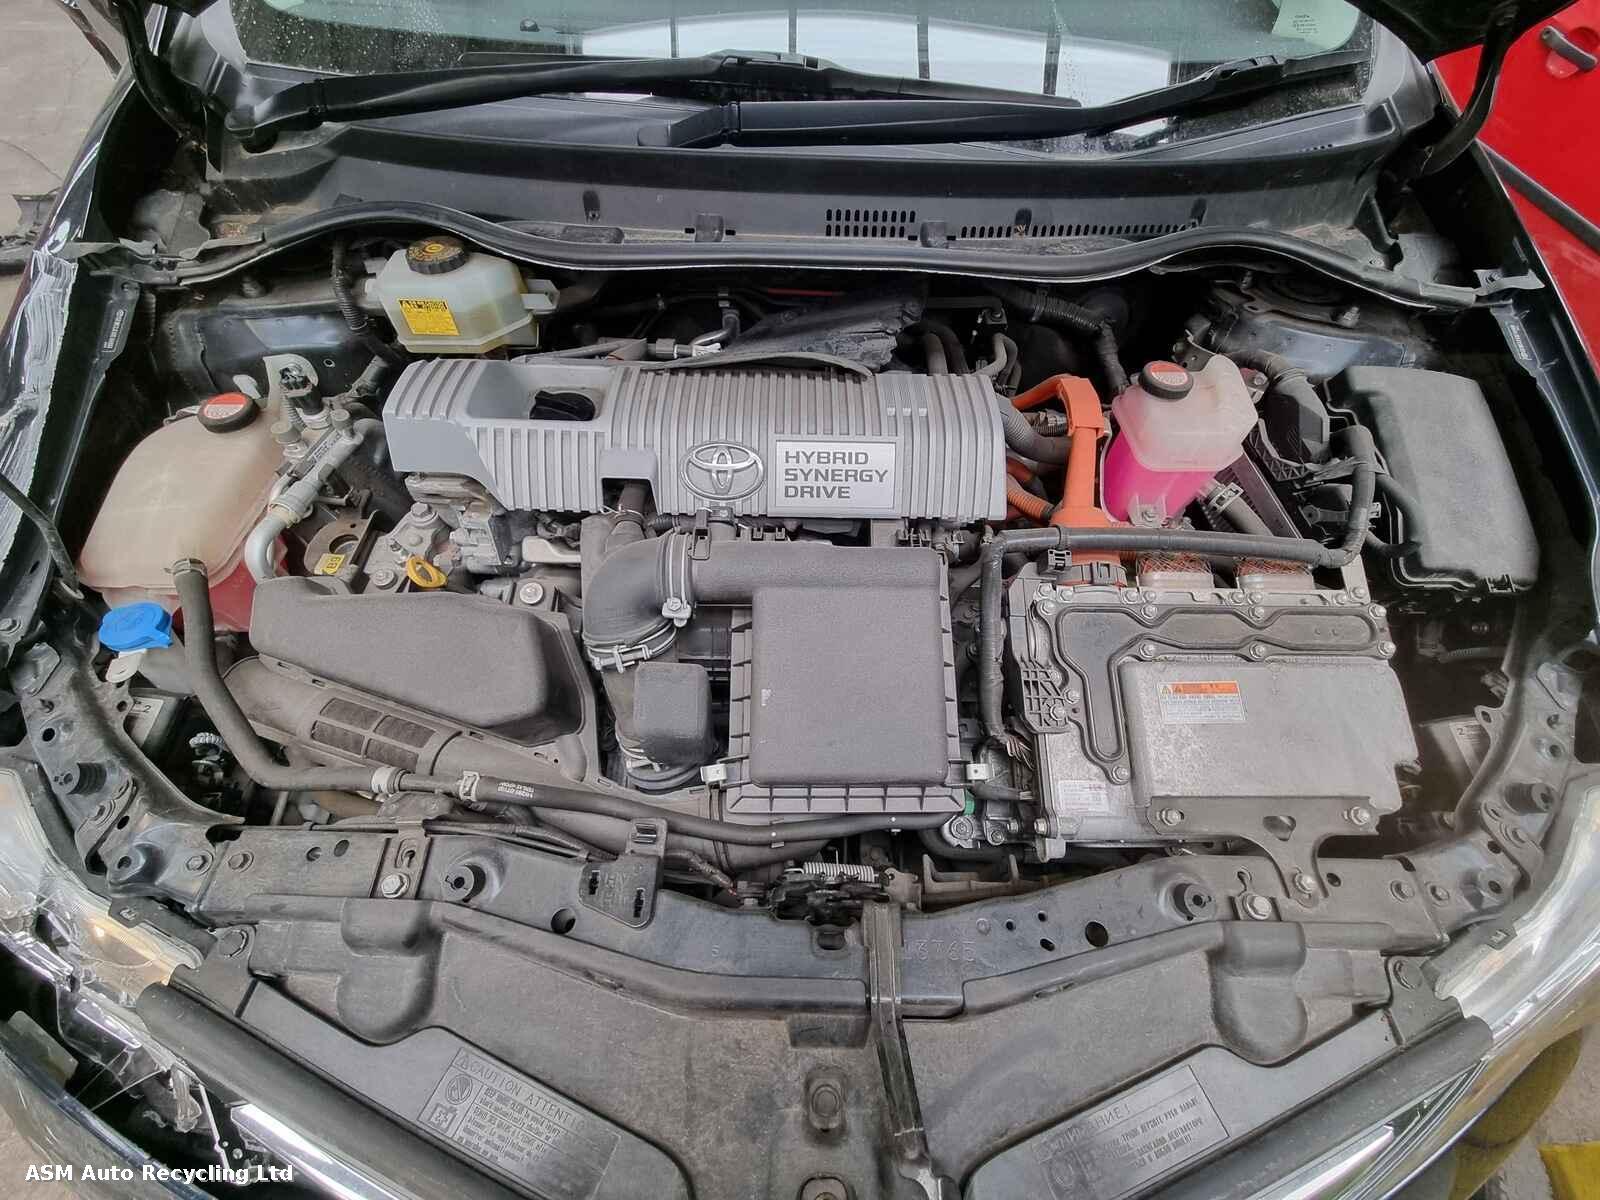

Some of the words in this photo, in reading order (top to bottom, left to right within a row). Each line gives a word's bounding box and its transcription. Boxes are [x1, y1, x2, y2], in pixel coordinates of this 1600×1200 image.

[785, 451, 869, 465] HYBRID
[784, 468, 888, 482] SYNERGY
[784, 485, 850, 499] DRIVE
[468, 1060, 521, 1096] CAUTION
